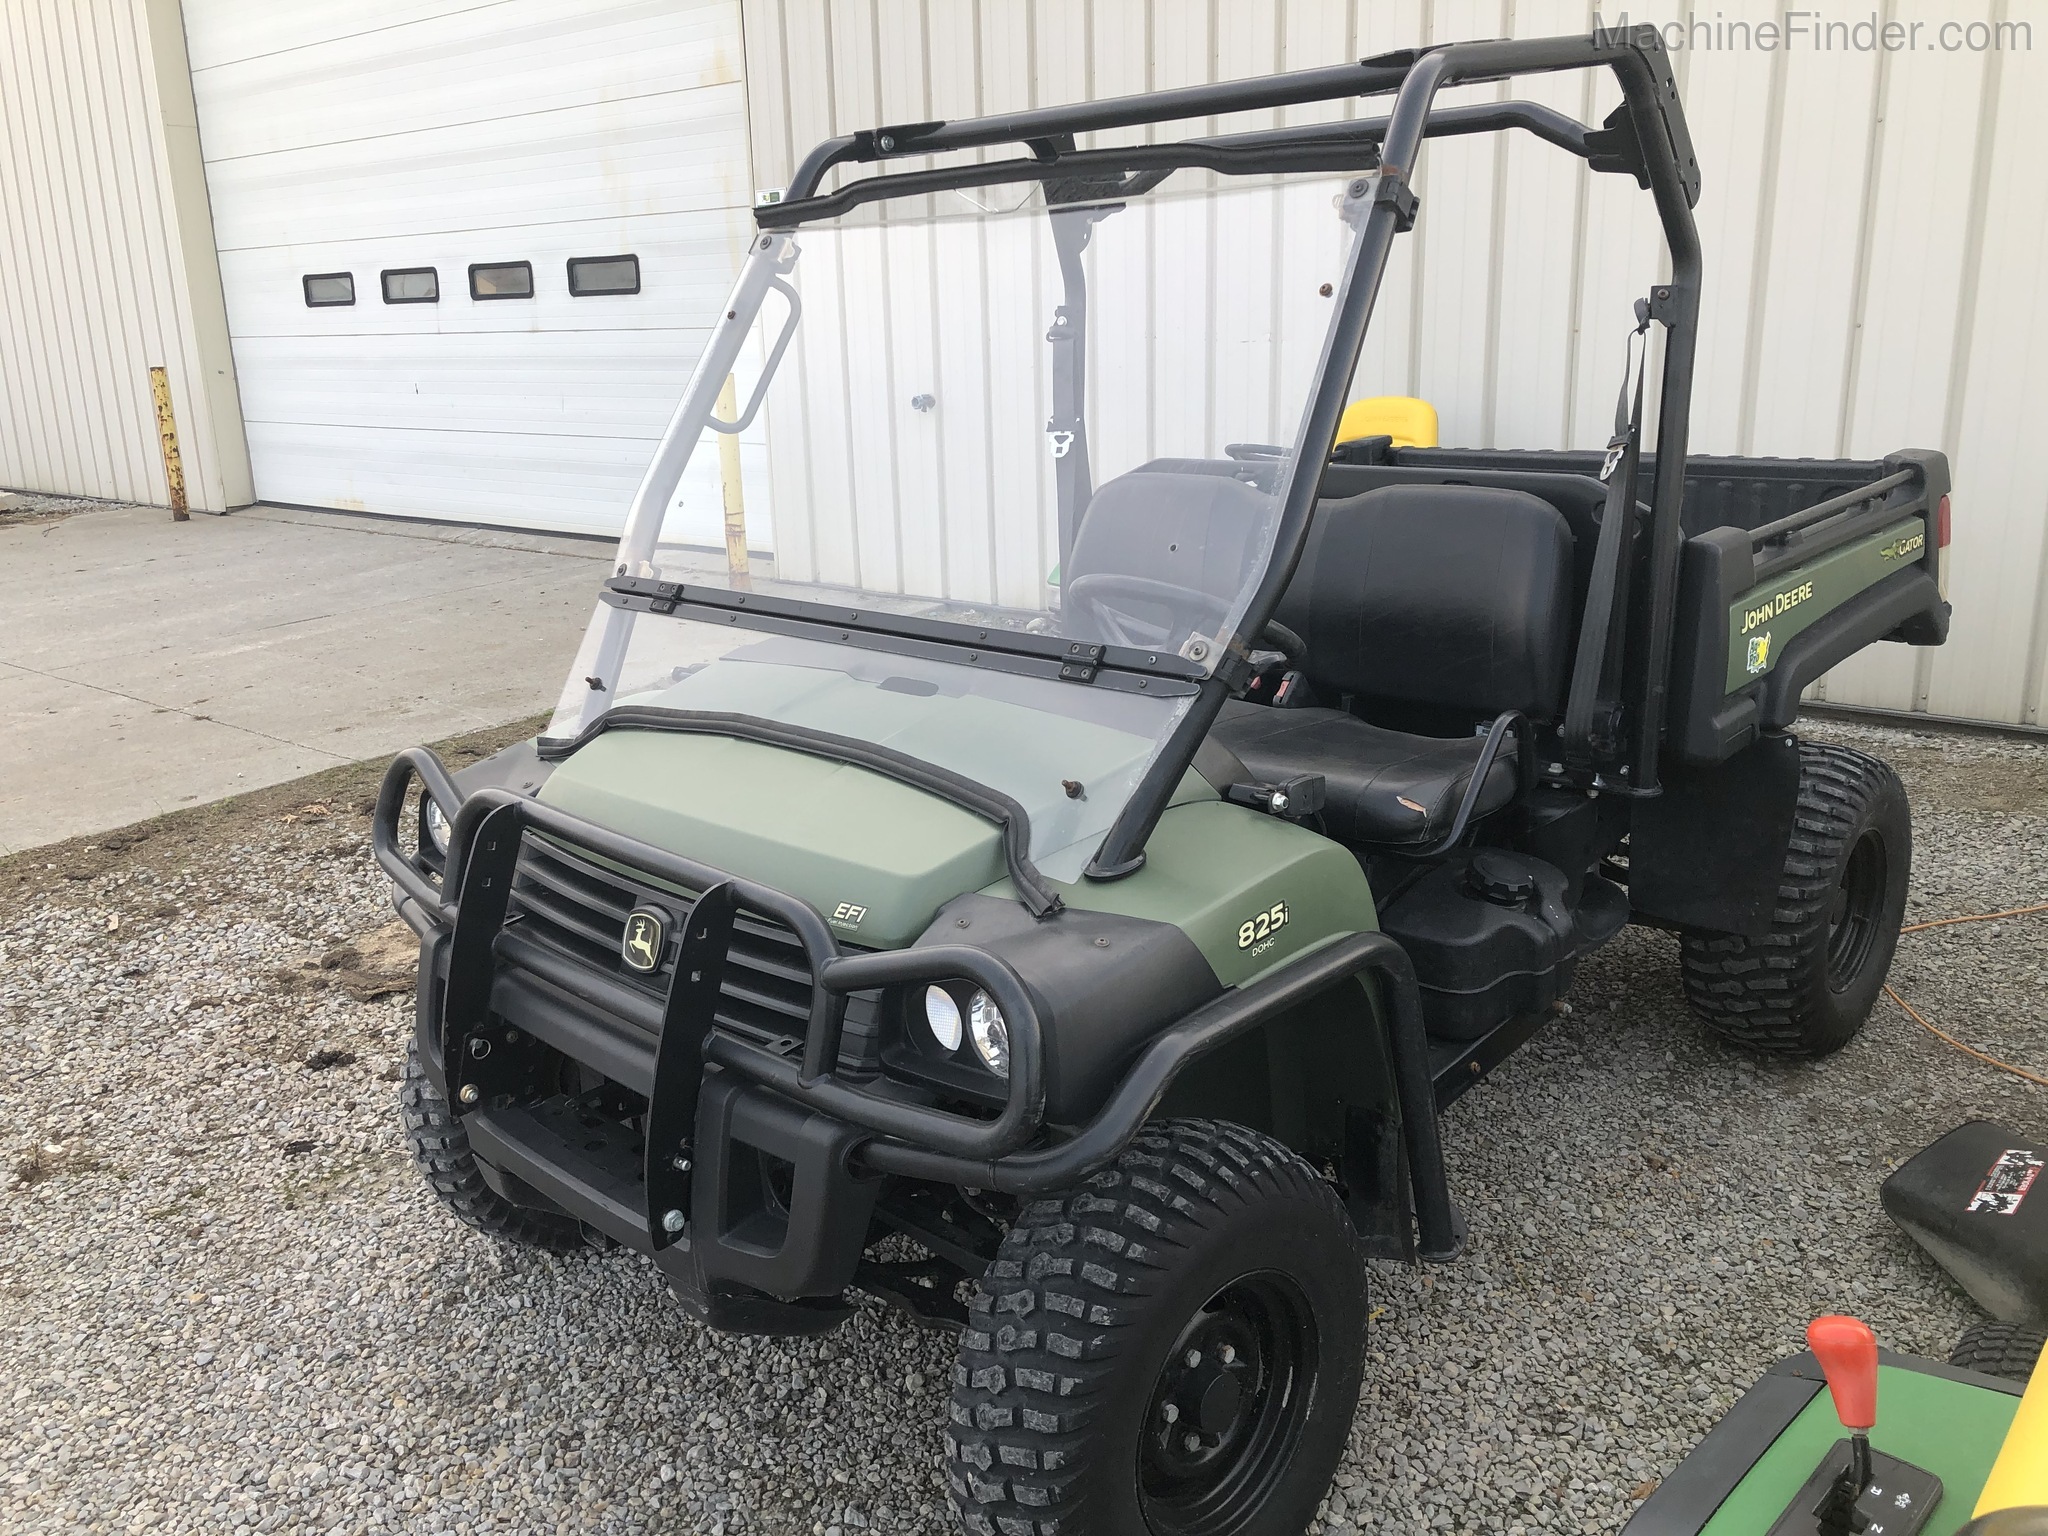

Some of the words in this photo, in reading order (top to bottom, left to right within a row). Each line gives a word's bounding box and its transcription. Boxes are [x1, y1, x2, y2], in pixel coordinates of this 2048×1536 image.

[1899, 533, 1924, 556] GATOR
[1741, 600, 1774, 635] JOHN
[1775, 581, 1813, 616] DEERE
[833, 902, 867, 923] EFI
[1238, 901, 1289, 949] 825i
[1252, 937, 1275, 957] DOHC
